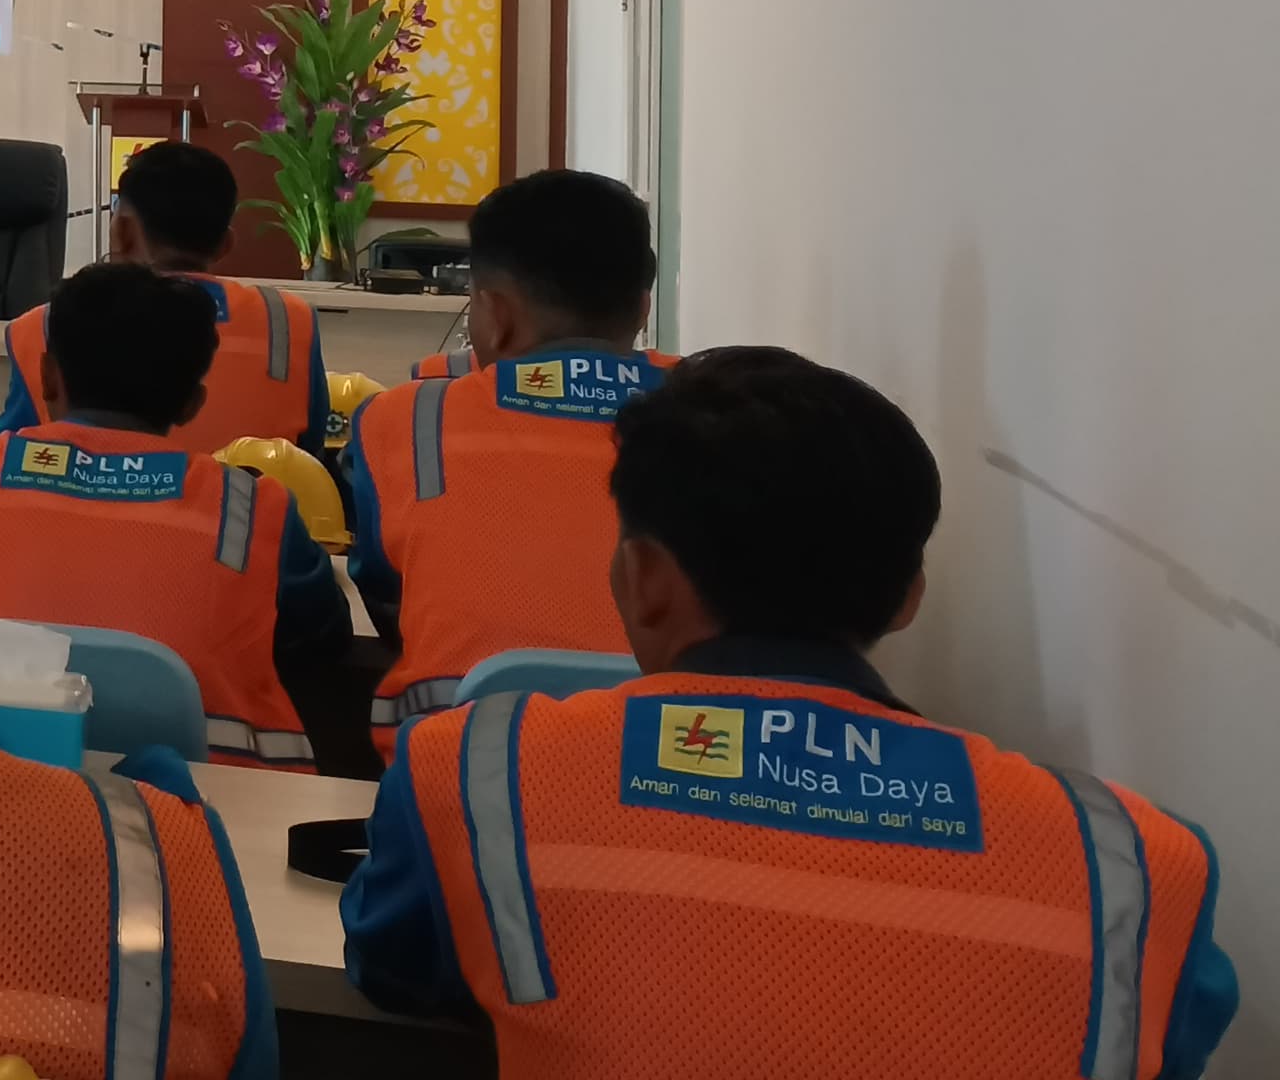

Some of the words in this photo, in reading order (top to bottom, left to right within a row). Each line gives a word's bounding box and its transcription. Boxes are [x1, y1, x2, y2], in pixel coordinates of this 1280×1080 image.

[570, 358, 640, 384] PLN
[570, 383, 617, 401] Nusa
[75, 449, 143, 472] PLN
[72, 467, 117, 485] Nusa
[125, 472, 174, 486] Daya
[761, 710, 881, 766] PLN
[758, 753, 841, 795] Nusa
[861, 773, 954, 807] Daya
[630, 775, 679, 796] Aman
[689, 784, 720, 802] dan
[729, 791, 797, 815] selamat
[807, 803, 869, 825] dimulai
[878, 811, 912, 829] dari
[922, 817, 966, 836] saya
